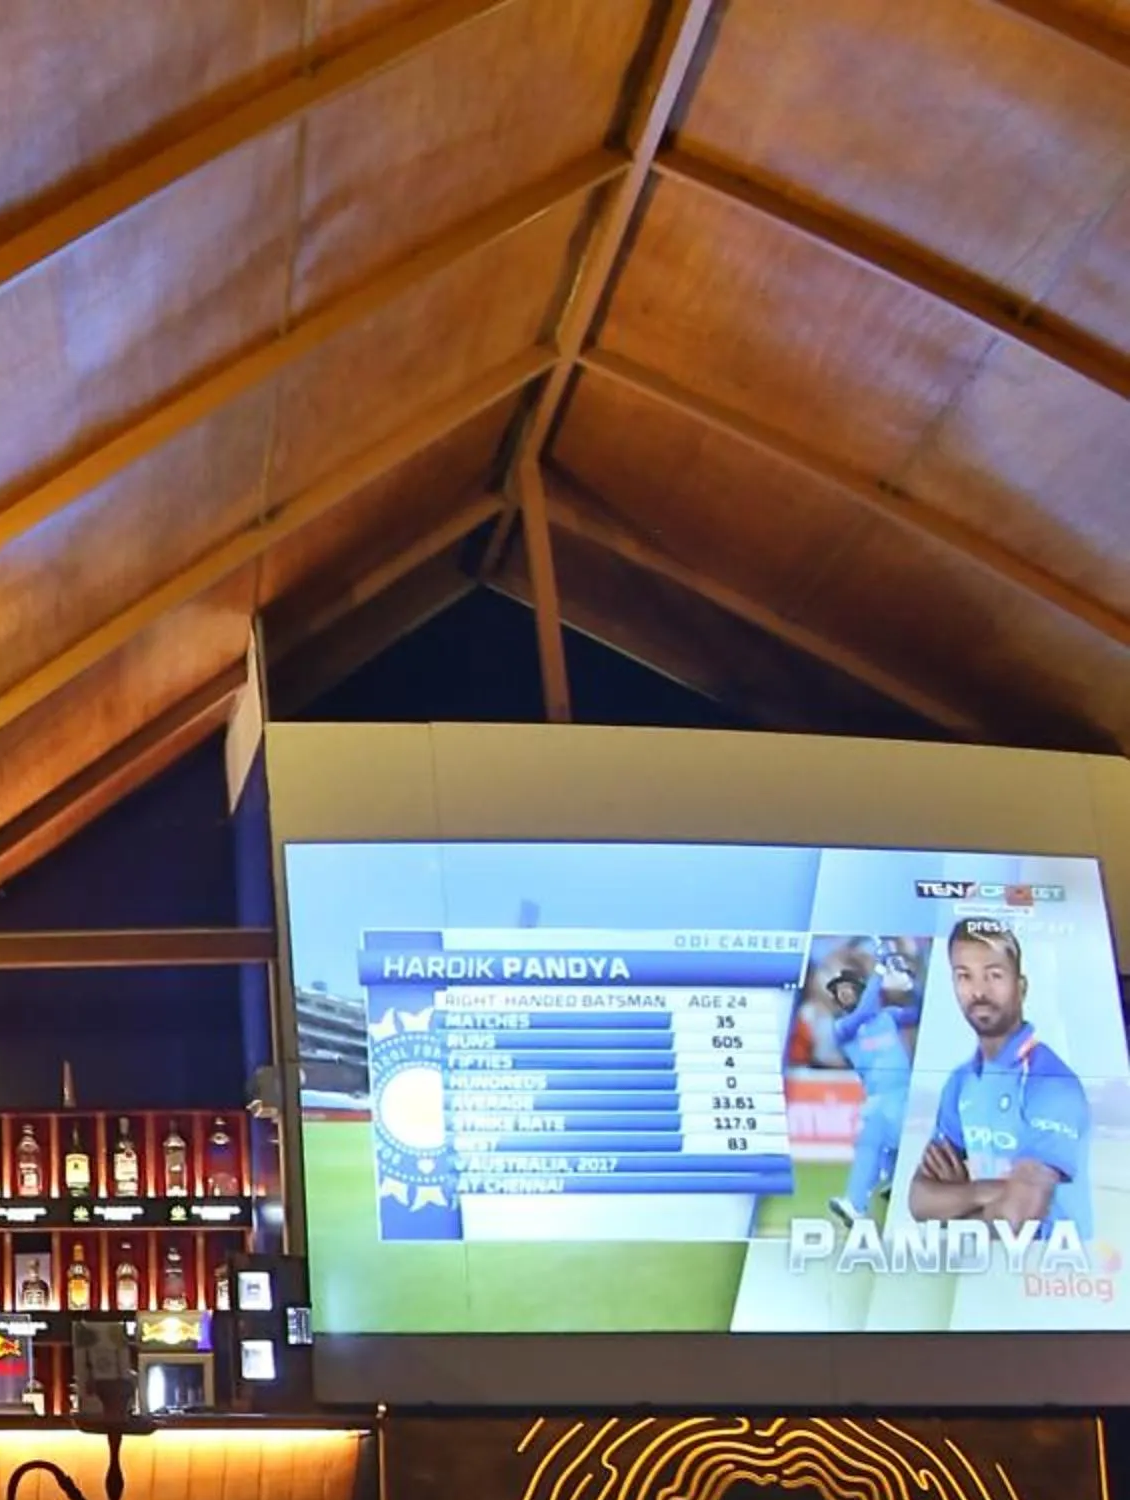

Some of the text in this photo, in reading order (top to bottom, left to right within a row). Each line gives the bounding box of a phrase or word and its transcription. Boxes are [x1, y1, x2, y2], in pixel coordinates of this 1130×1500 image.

[674, 935, 800, 949] ODI CAREER
[383, 956, 630, 980] HARDIK PANDYA
[581, 994, 667, 1009] BATSMAN
[688, 995, 748, 1009] AGE 24
[444, 1014, 531, 1029] MATCHES
[716, 1016, 736, 1029] 35
[447, 1034, 496, 1049] RUNS
[712, 1036, 743, 1049] 605
[448, 1054, 513, 1070] FIFTIES
[725, 1057, 736, 1068] 4
[713, 1097, 755, 1111] 33.61
[715, 1118, 757, 1131] 117.9
[728, 1138, 748, 1151] 83
[577, 1157, 618, 1171] 2017
[789, 1218, 1089, 1273] PANDYA
[1024, 1275, 1115, 1301] Dialog
